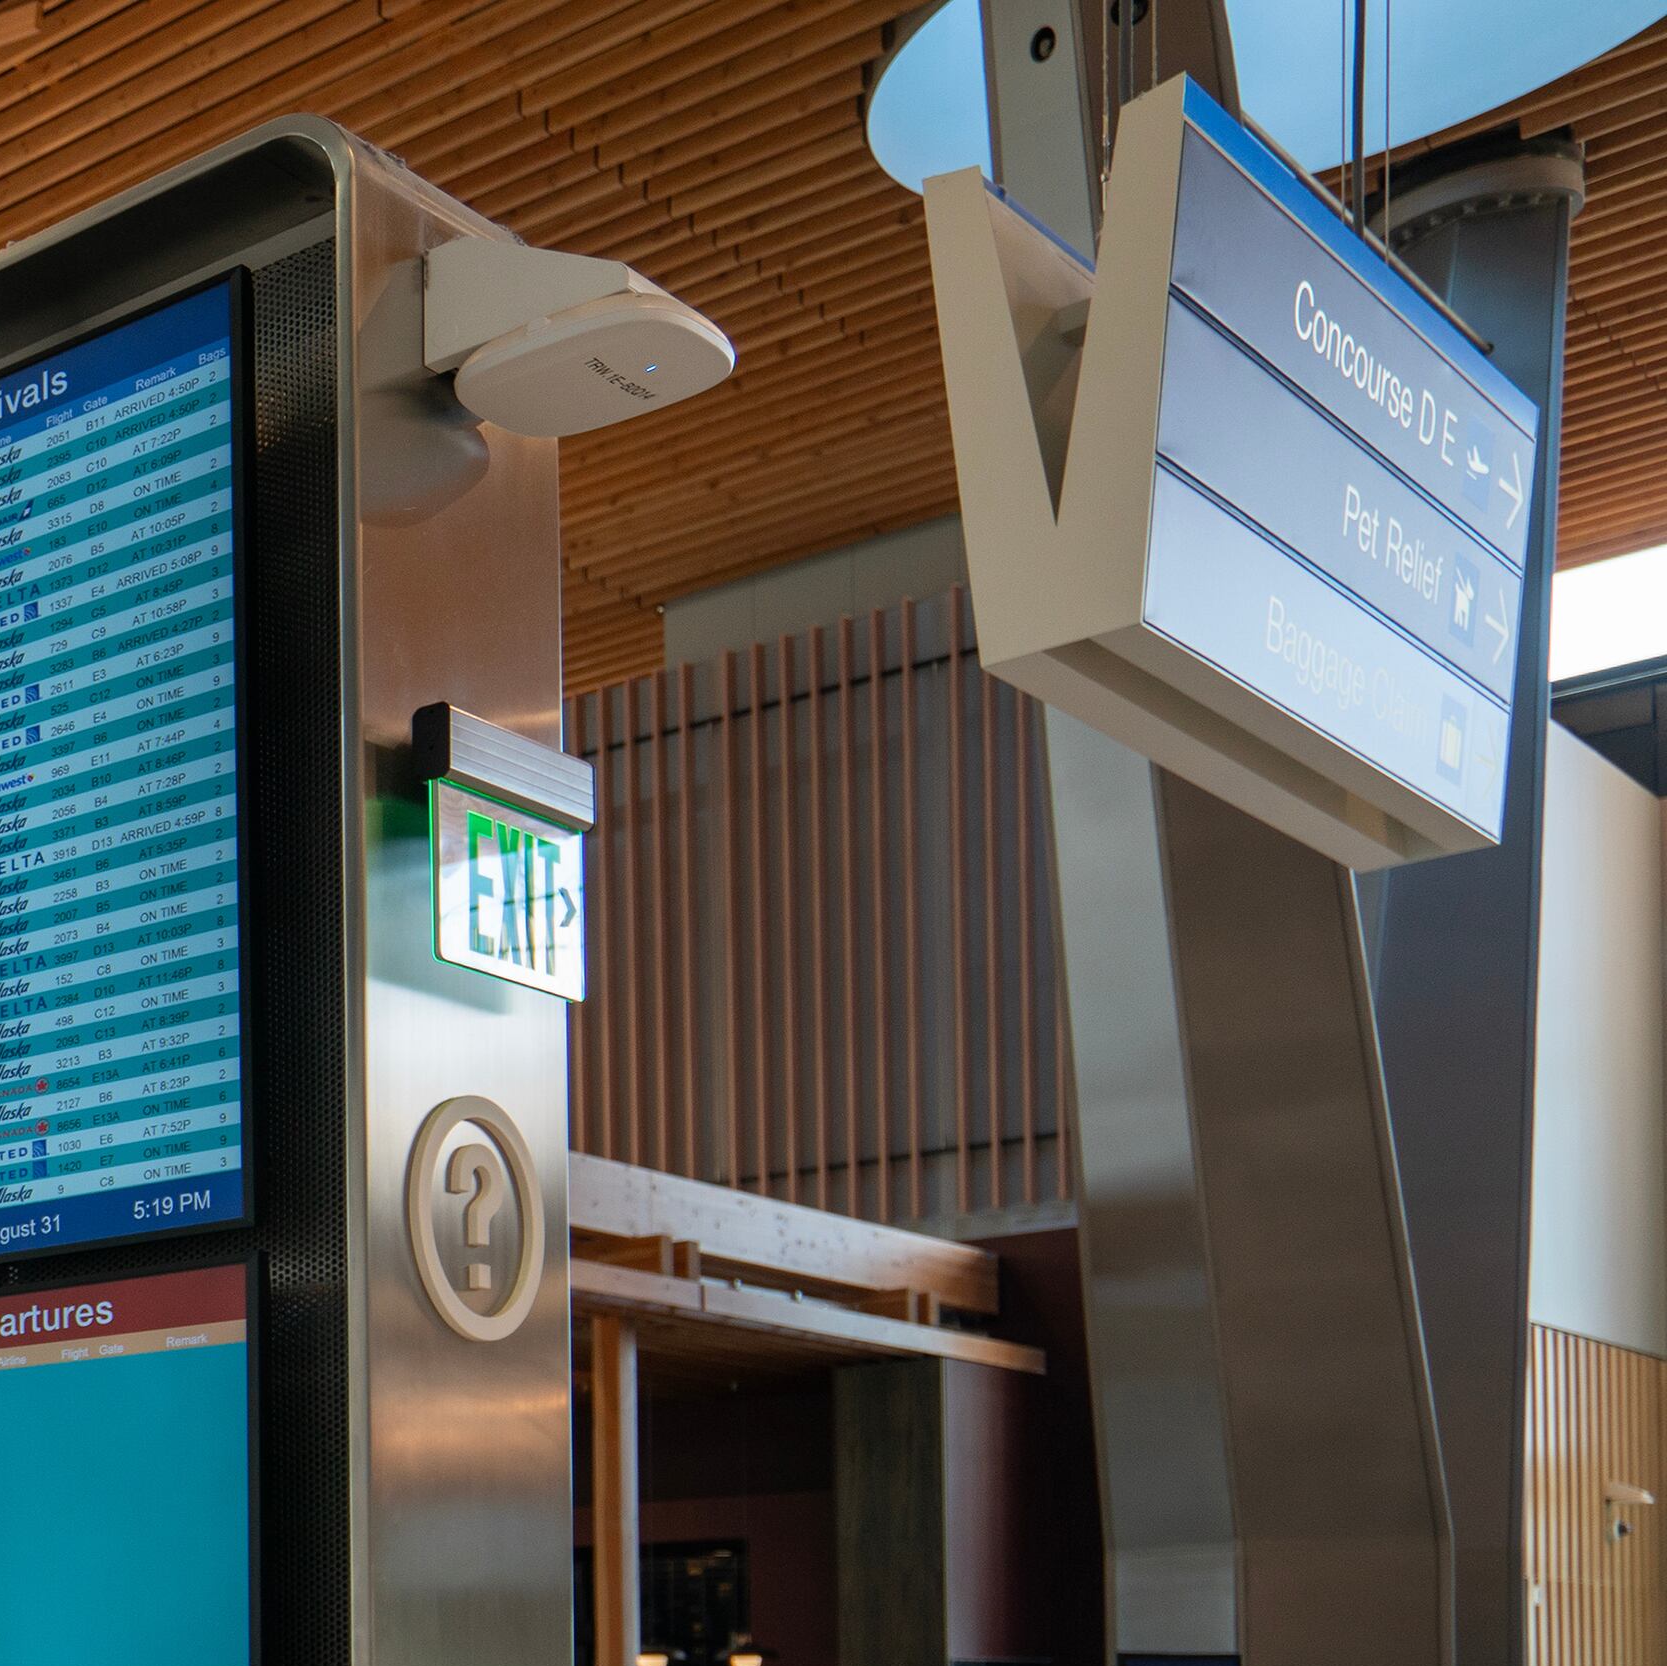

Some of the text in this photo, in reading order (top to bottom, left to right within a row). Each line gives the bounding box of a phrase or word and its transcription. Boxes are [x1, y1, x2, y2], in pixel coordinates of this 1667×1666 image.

[46, 408, 73, 428] Flight
[83, 395, 108, 412] Gate
[135, 366, 176, 391] Remark
[198, 348, 226, 366] Bags
[46, 430, 70, 448] 2051
[86, 416, 105, 432] B11
[114, 392, 165, 421] ARRIVED
[168, 377, 199, 398] 4:50P
[209, 371, 216, 383] 2
[1295, 280, 1458, 466] Concourse D E
[1343, 484, 1443, 605] Pet Relief
[1267, 595, 1426, 740] Baggage Claim
[465, 810, 562, 977] EXIT
[41, 1214, 60, 1234] 31
[133, 1196, 174, 1220] 5:19
[179, 1189, 211, 1213] PM
[61, 1346, 89, 1362] Flight
[98, 1343, 124, 1355] Gate
[166, 1332, 208, 1349] Remark
